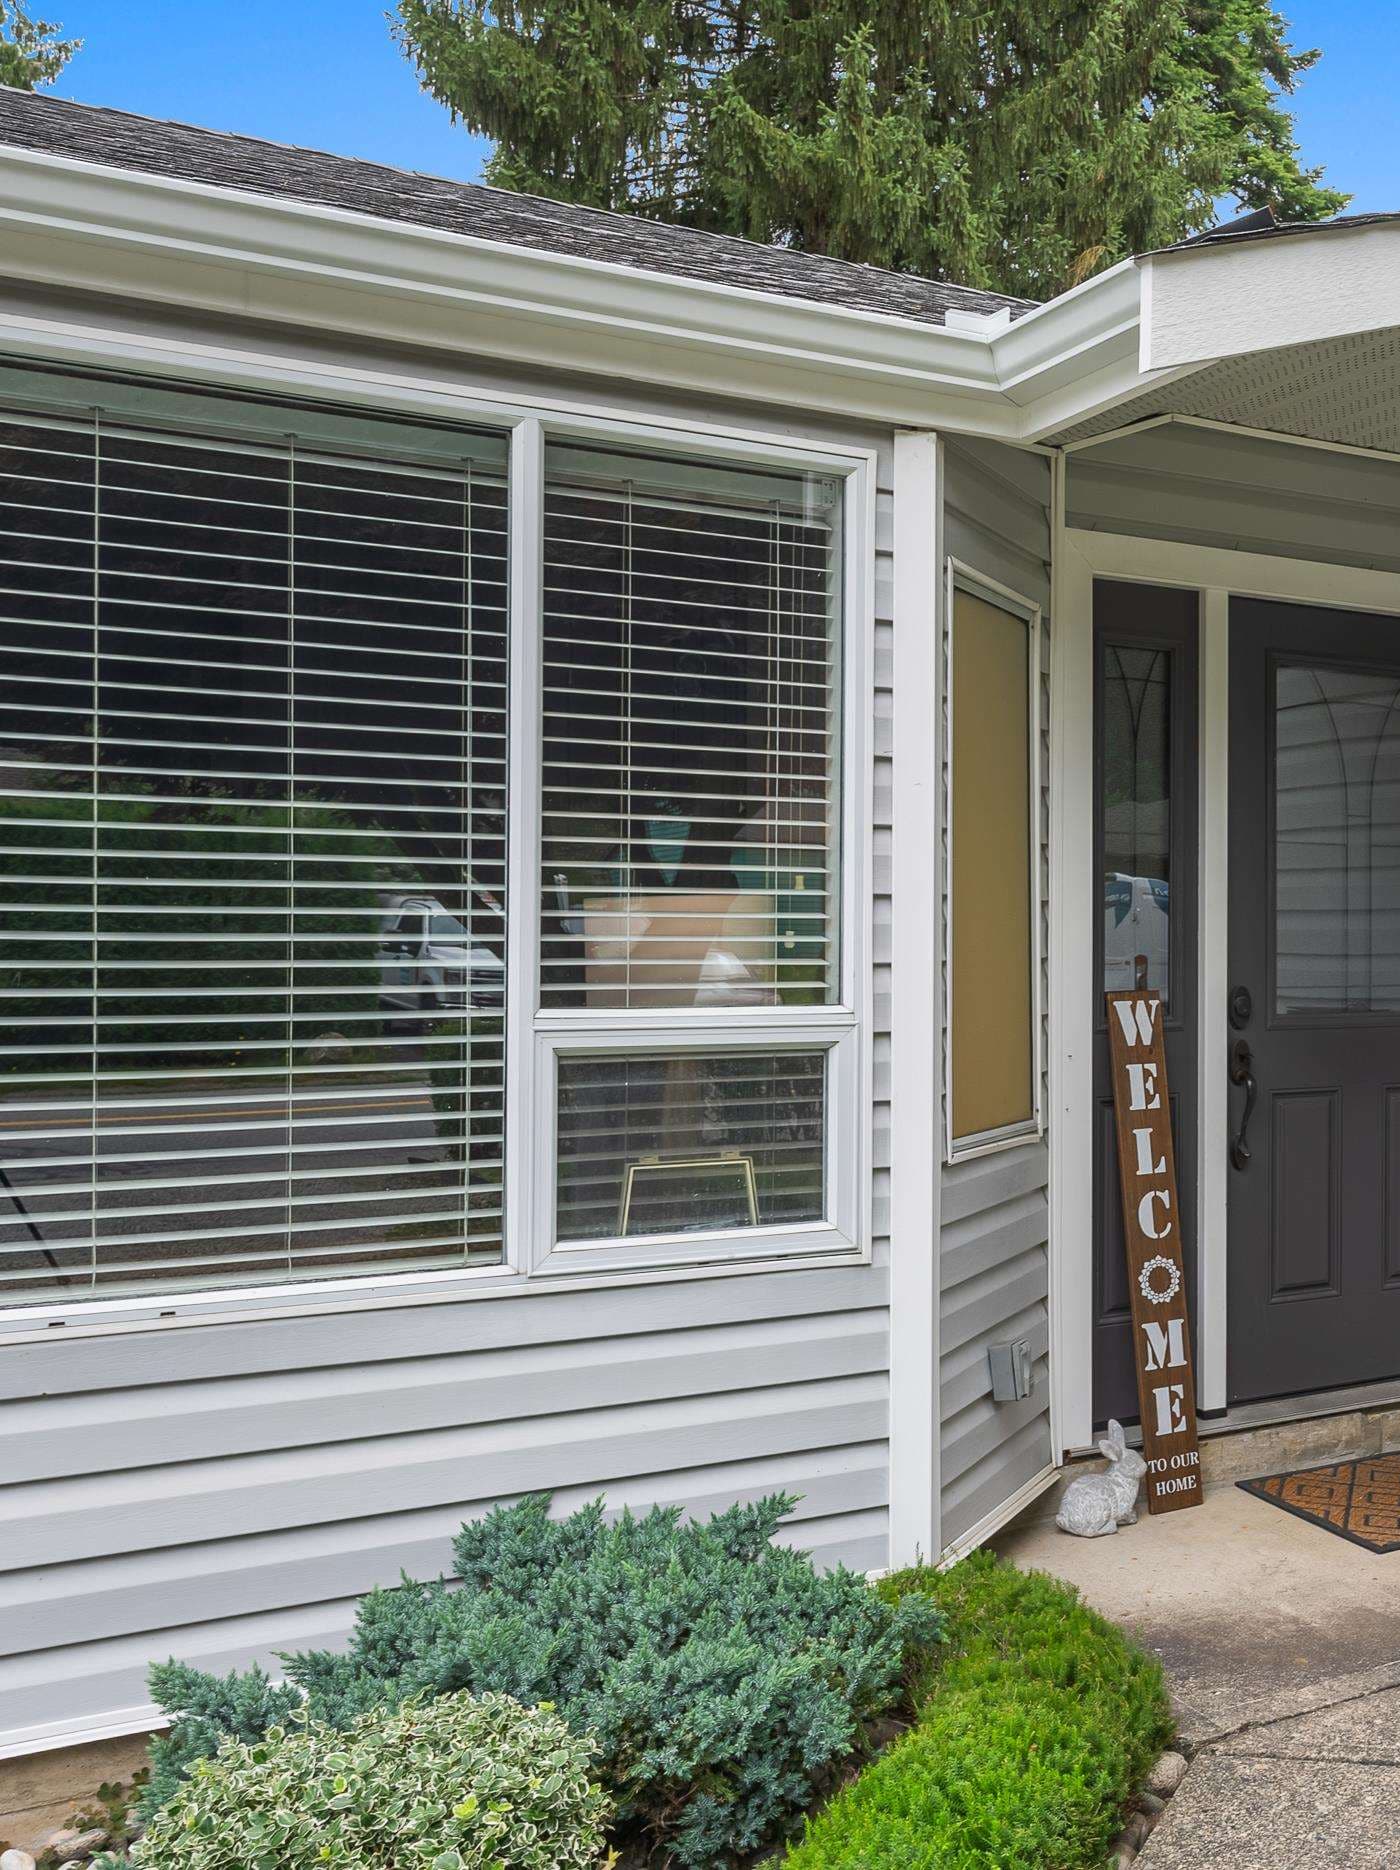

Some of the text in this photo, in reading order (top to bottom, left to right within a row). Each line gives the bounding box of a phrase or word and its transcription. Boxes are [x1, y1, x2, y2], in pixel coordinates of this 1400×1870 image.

[1112, 1000, 1188, 1436] WELCOME
[1148, 1451, 1199, 1474] TO OUR
[1155, 1475, 1197, 1496] HOME
